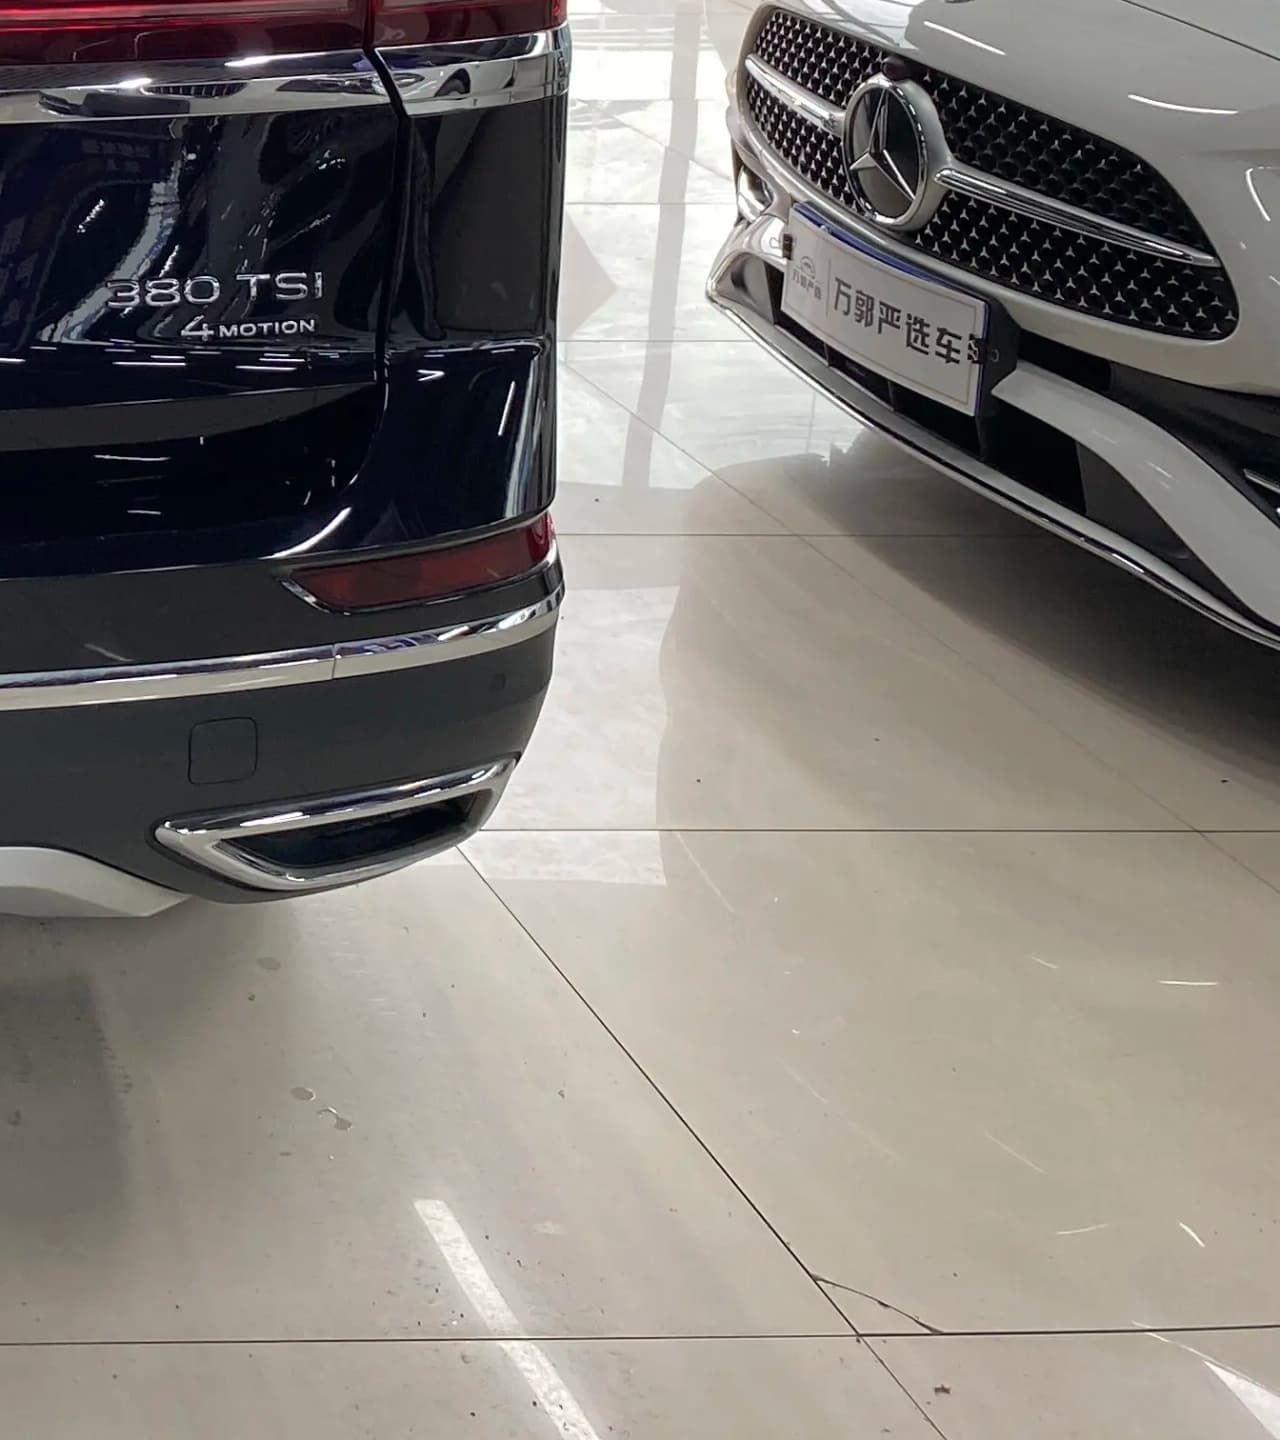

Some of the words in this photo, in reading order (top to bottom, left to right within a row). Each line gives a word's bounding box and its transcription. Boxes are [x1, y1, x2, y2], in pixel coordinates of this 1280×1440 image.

[107, 275, 221, 308] 380
[236, 271, 323, 300] TSI
[834, 277, 962, 365] 万郭严选车
